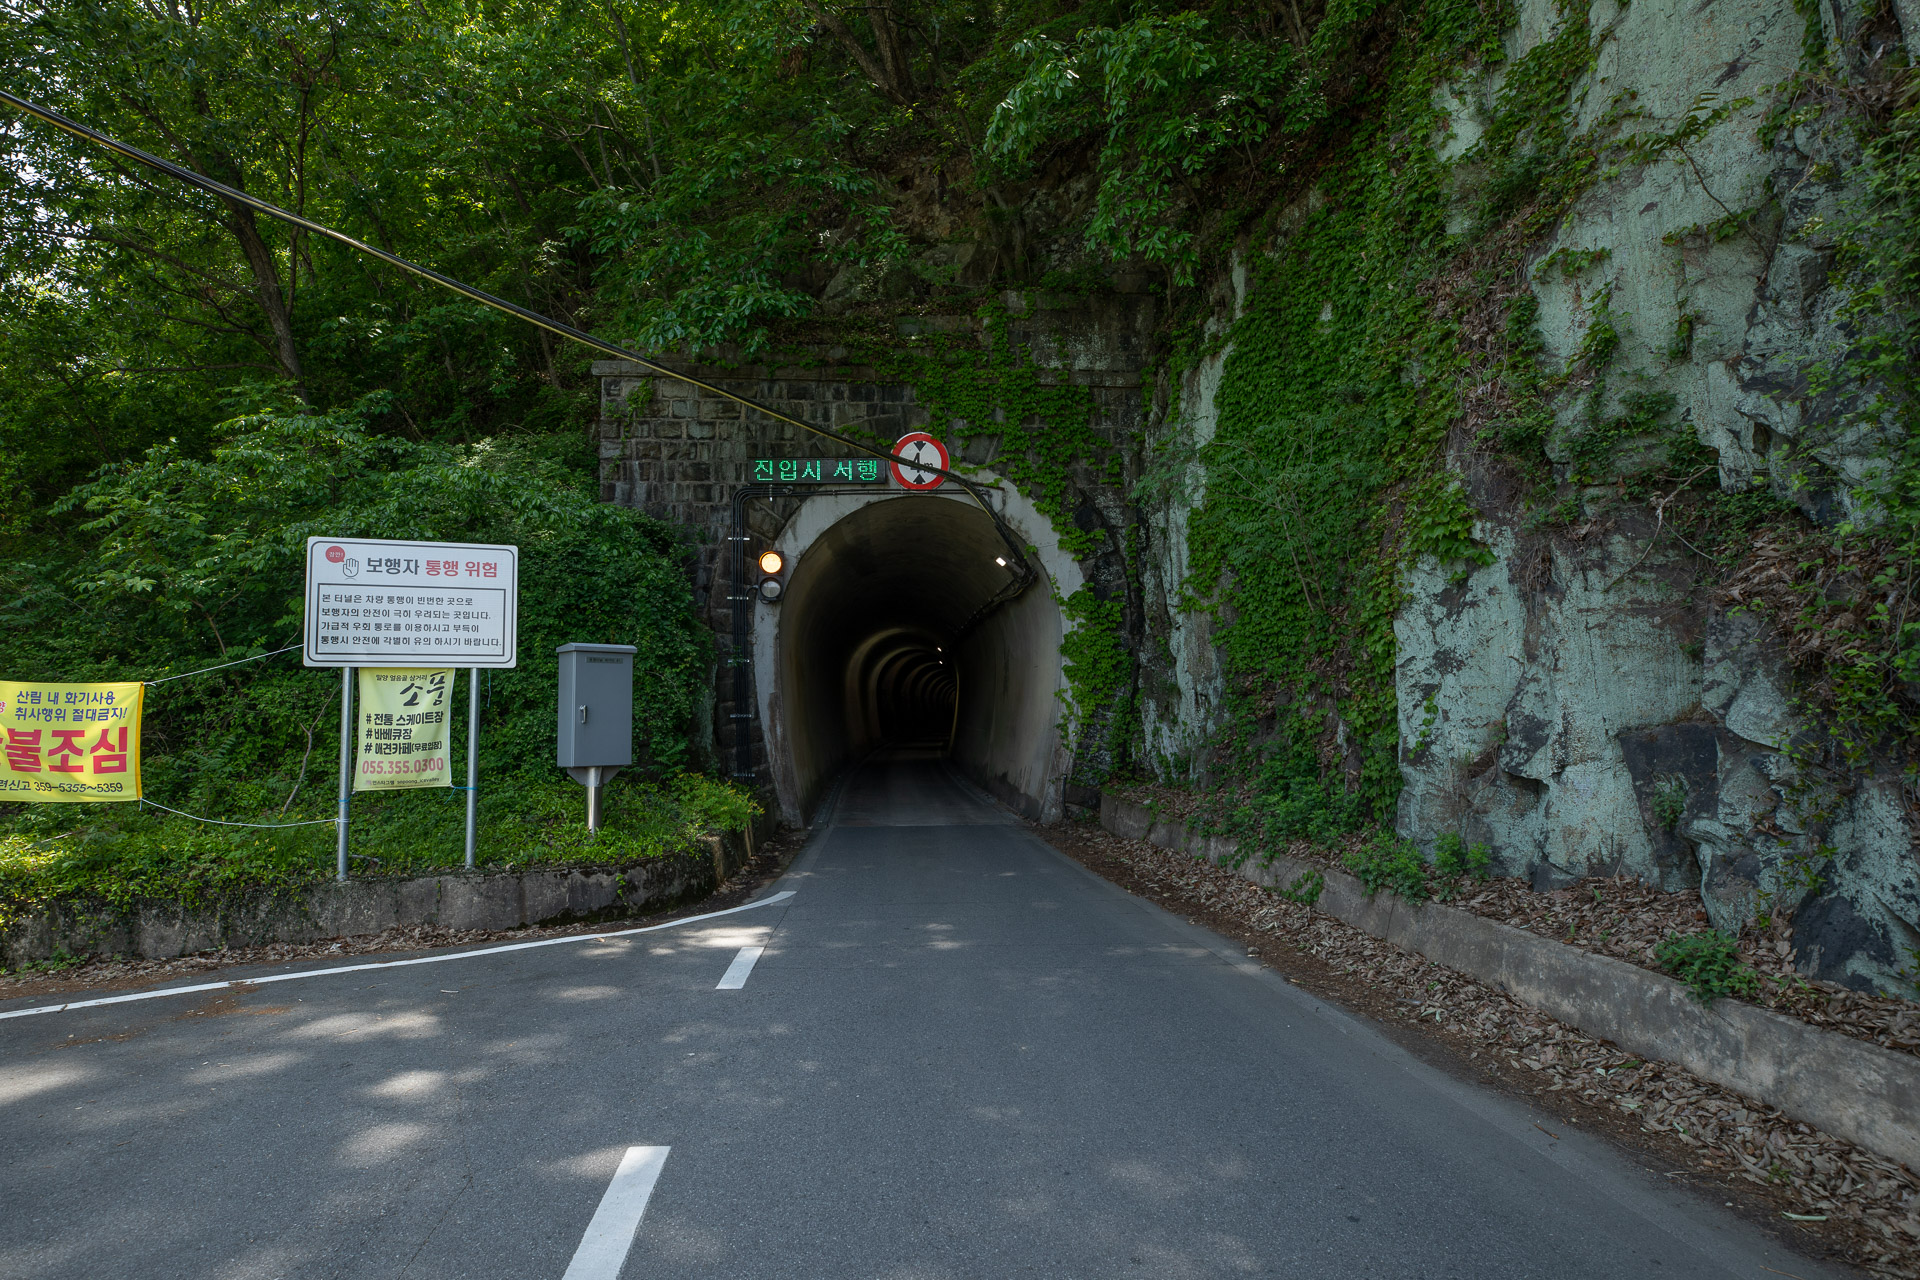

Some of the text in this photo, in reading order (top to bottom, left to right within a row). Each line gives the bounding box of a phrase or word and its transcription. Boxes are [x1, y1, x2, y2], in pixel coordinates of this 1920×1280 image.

[754, 460, 877, 481] 진입시 서행
[366, 557, 497, 578] 보행자 통행 위험
[322, 594, 473, 606] 본 터널은 차량 통행이 빈번한 곳으로
[321, 608, 491, 620] 보행자의 안전이 극히 우려되는 곳입니다.
[321, 621, 479, 633] 가급적 우회 통로를 이용하시고 부득이
[321, 635, 502, 647] 통행시 안전에 각별히 유의 하시기 바랍니다.
[16, 690, 116, 706] 산림 내 화기사용
[15, 707, 67, 722] 취사행위
[72, 707, 128, 722] 절대금지!
[396, 711, 444, 726] 스케이트장
[0, 726, 128, 775] 불조심
[362, 757, 444, 775] 055.355.0300
